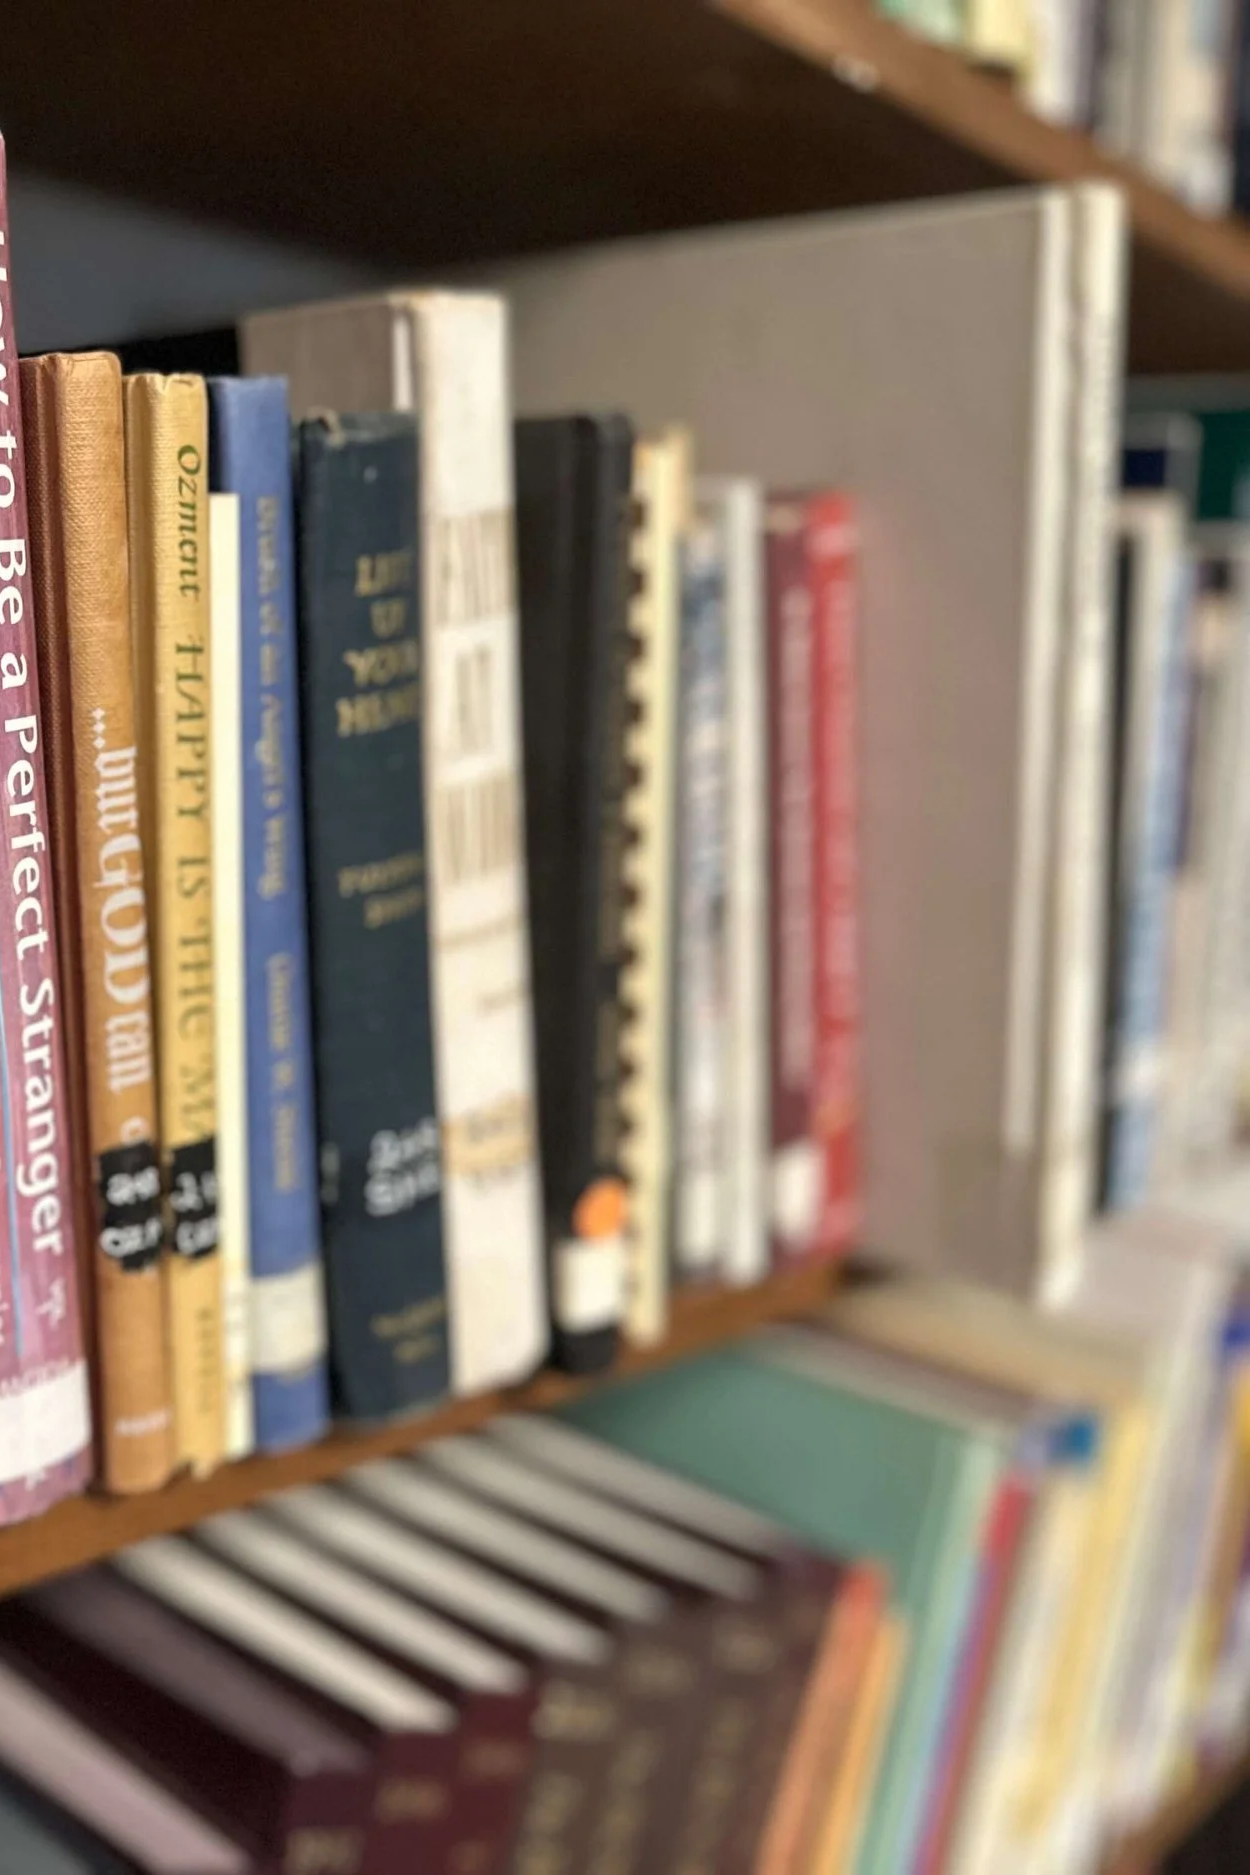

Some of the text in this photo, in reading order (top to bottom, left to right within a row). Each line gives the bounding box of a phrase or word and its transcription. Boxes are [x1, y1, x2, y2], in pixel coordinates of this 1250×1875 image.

[0, 651, 28, 691] a
[175, 634, 207, 820] HAPPY
[3, 714, 50, 962] Perfect
[95, 833, 150, 1005] GOD
[176, 856, 209, 899] IS
[15, 977, 65, 1256] Stranger
